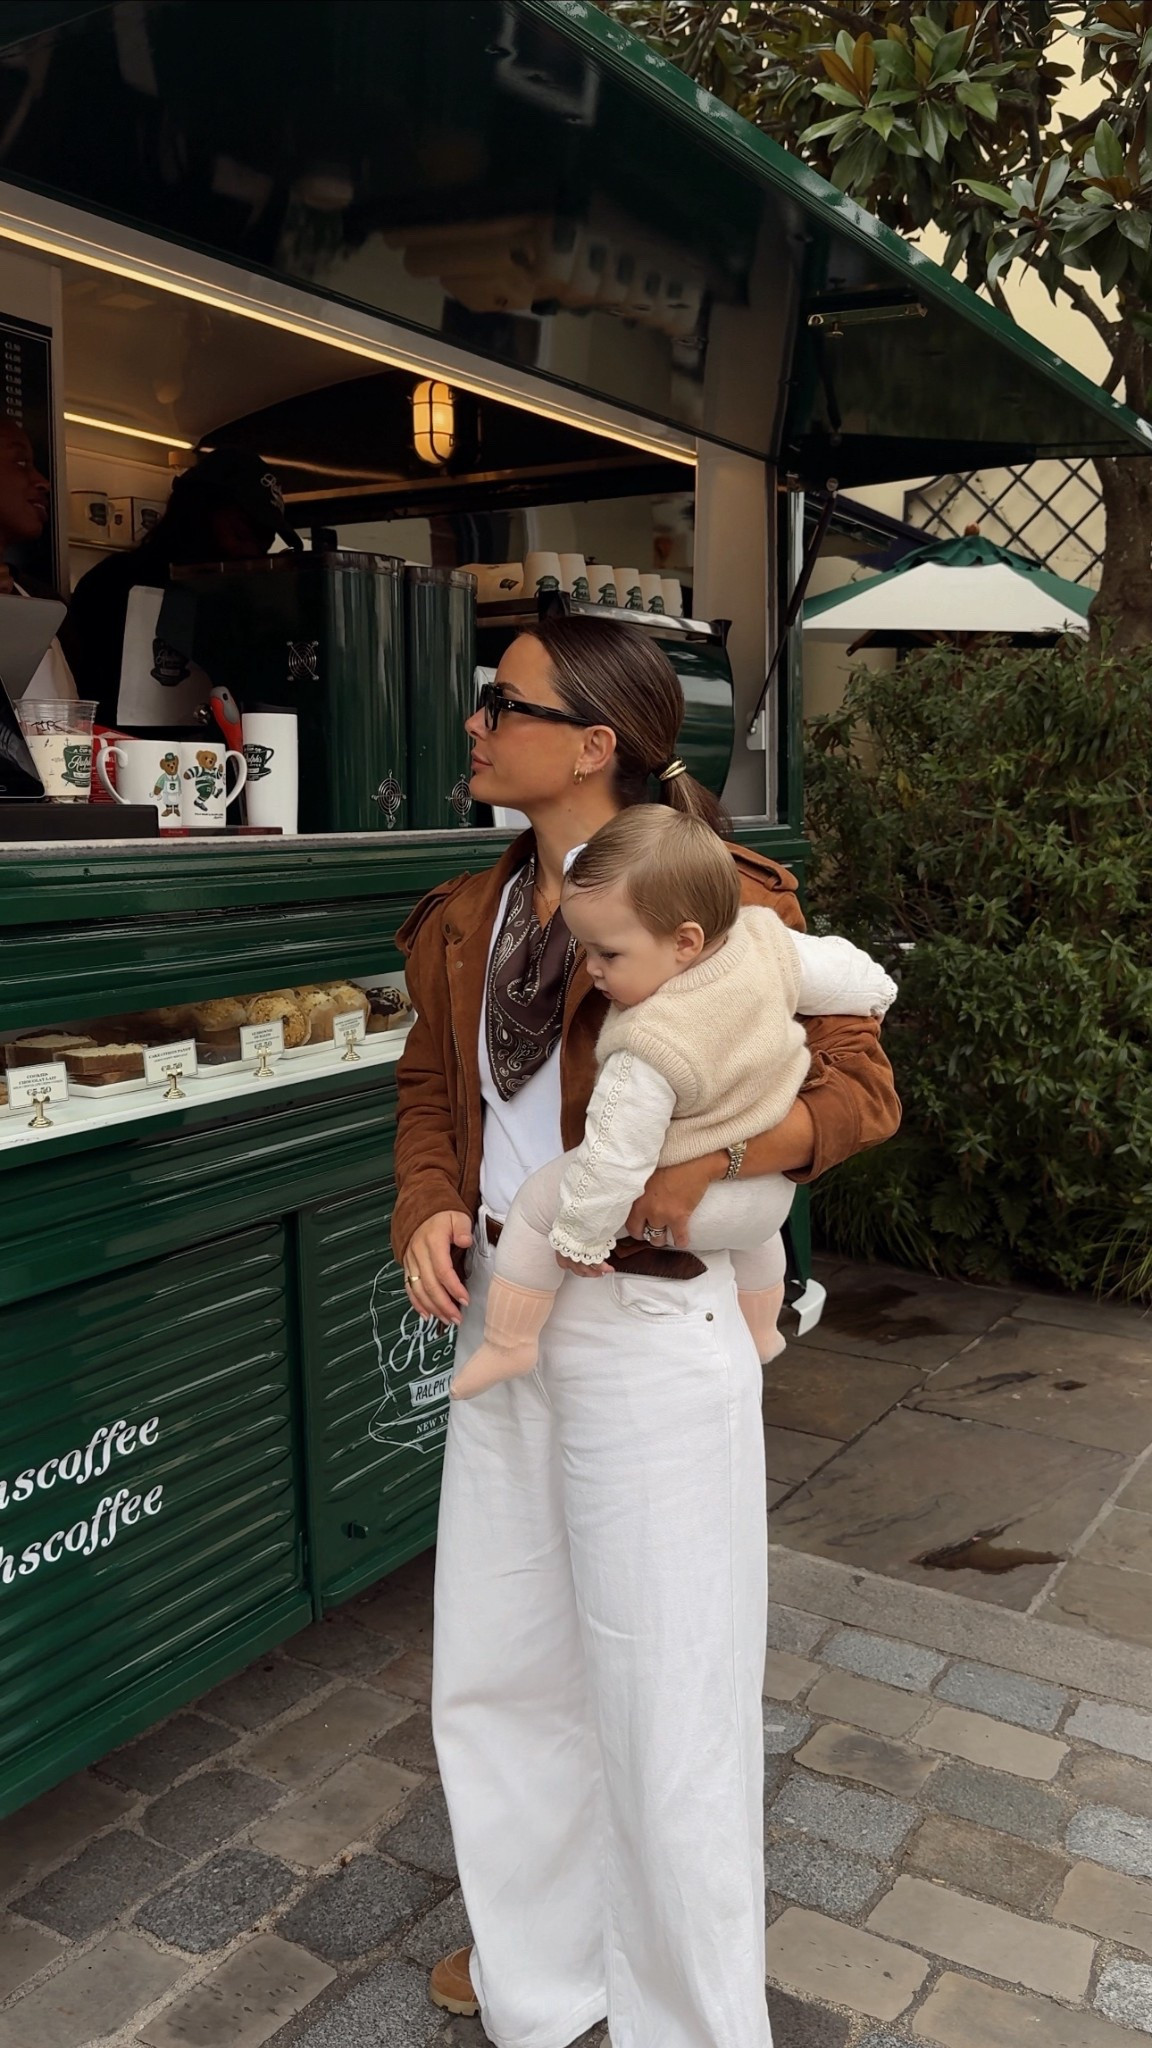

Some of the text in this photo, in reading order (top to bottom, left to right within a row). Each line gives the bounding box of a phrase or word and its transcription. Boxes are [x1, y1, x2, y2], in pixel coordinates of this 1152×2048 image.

[432, 1344, 456, 1362] CO
[415, 1377, 446, 1402] RALPH
[416, 1412, 449, 1434] NEW YO
